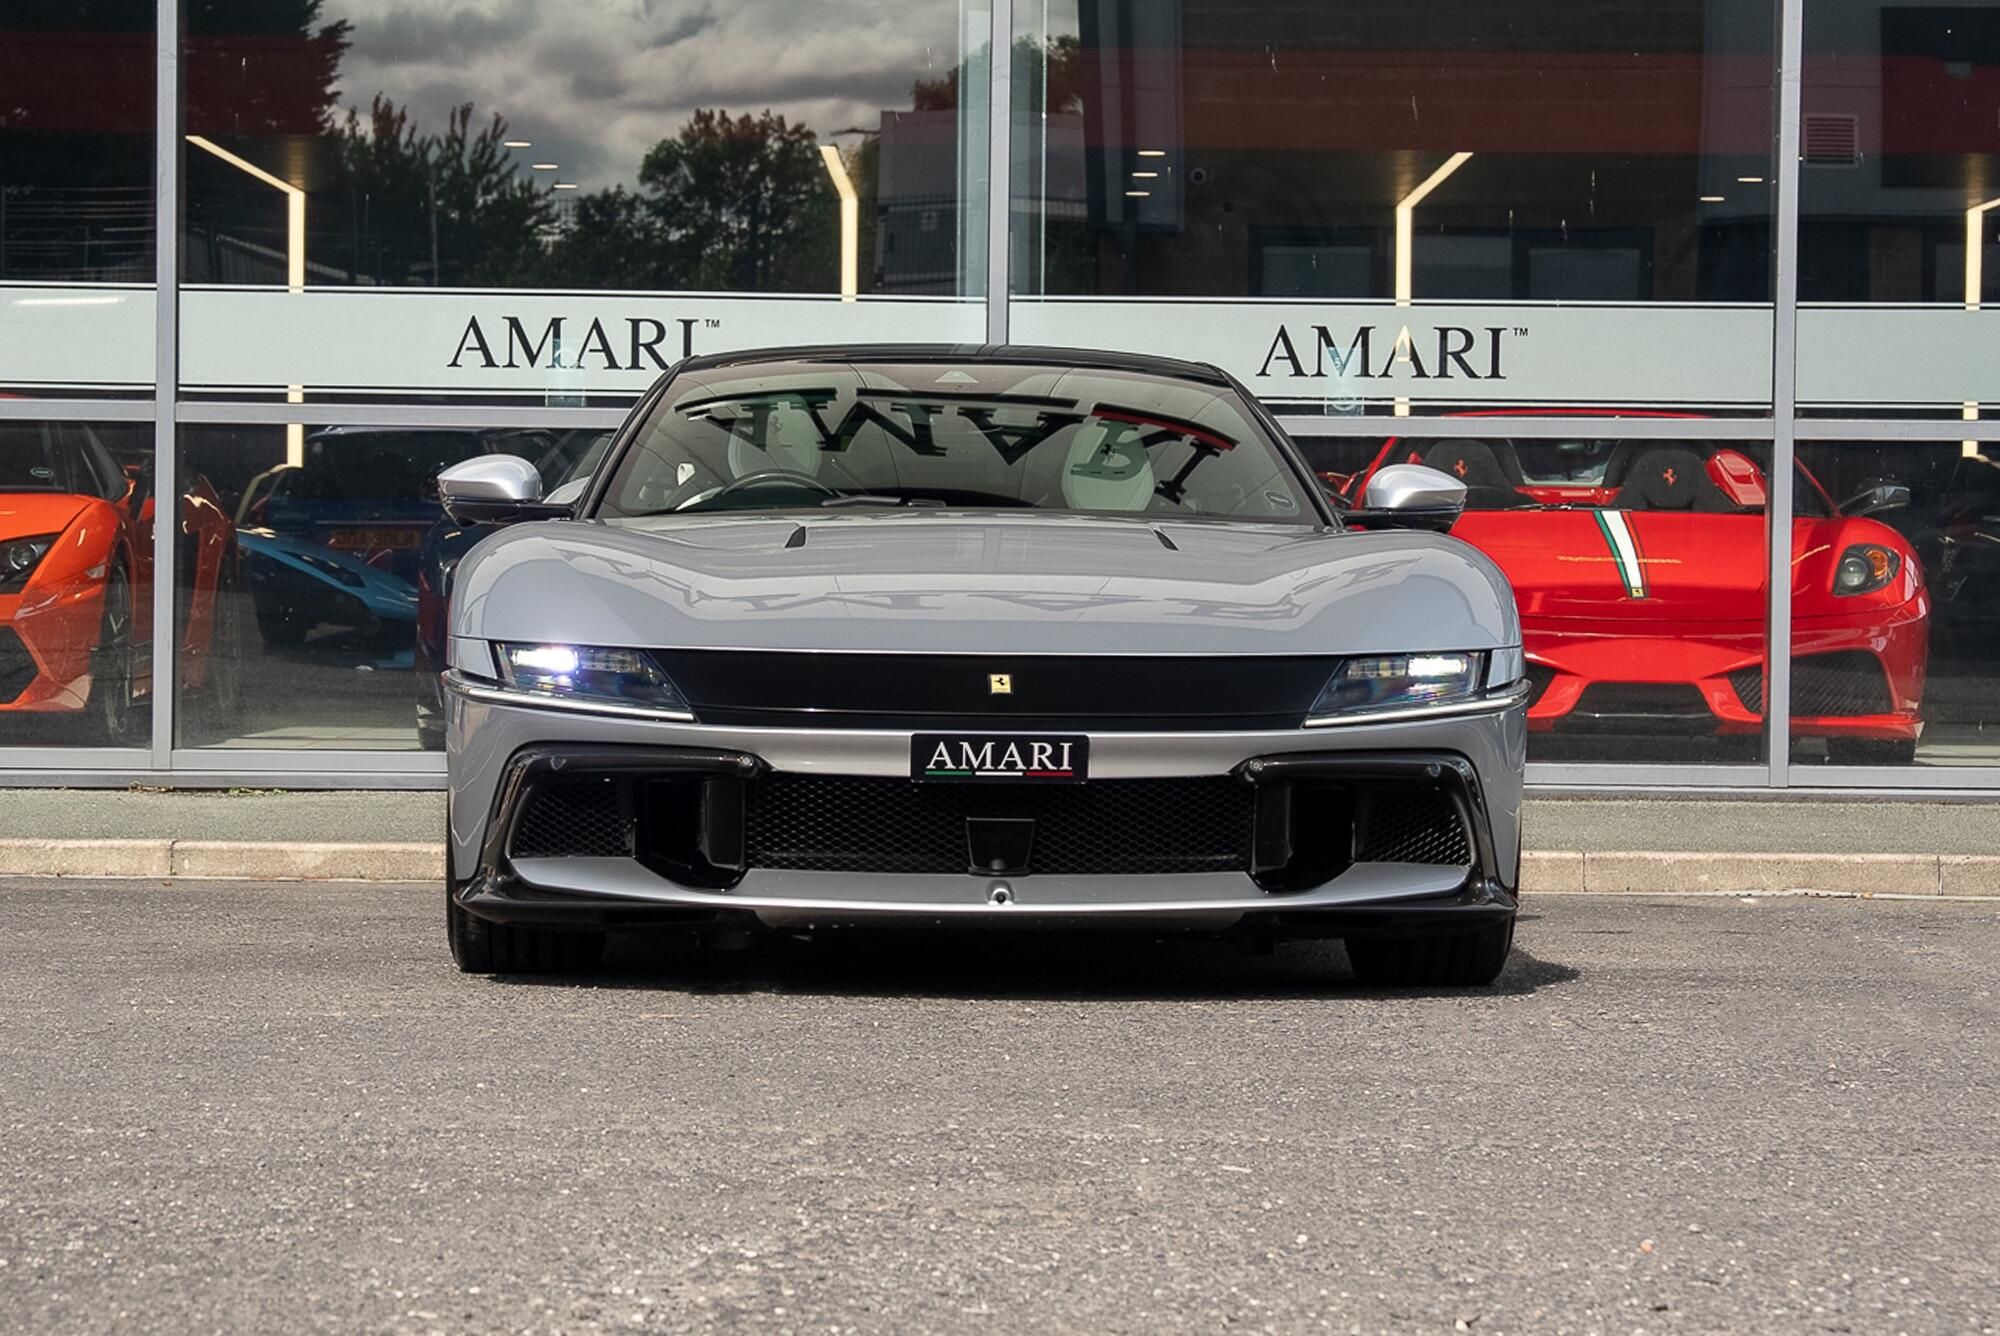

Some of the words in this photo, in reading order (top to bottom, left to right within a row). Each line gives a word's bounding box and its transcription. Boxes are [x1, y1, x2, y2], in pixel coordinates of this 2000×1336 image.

[447, 315, 699, 370] AMARI
[1256, 324, 1507, 379] AMARI
[926, 741, 1073, 770] AMARI
